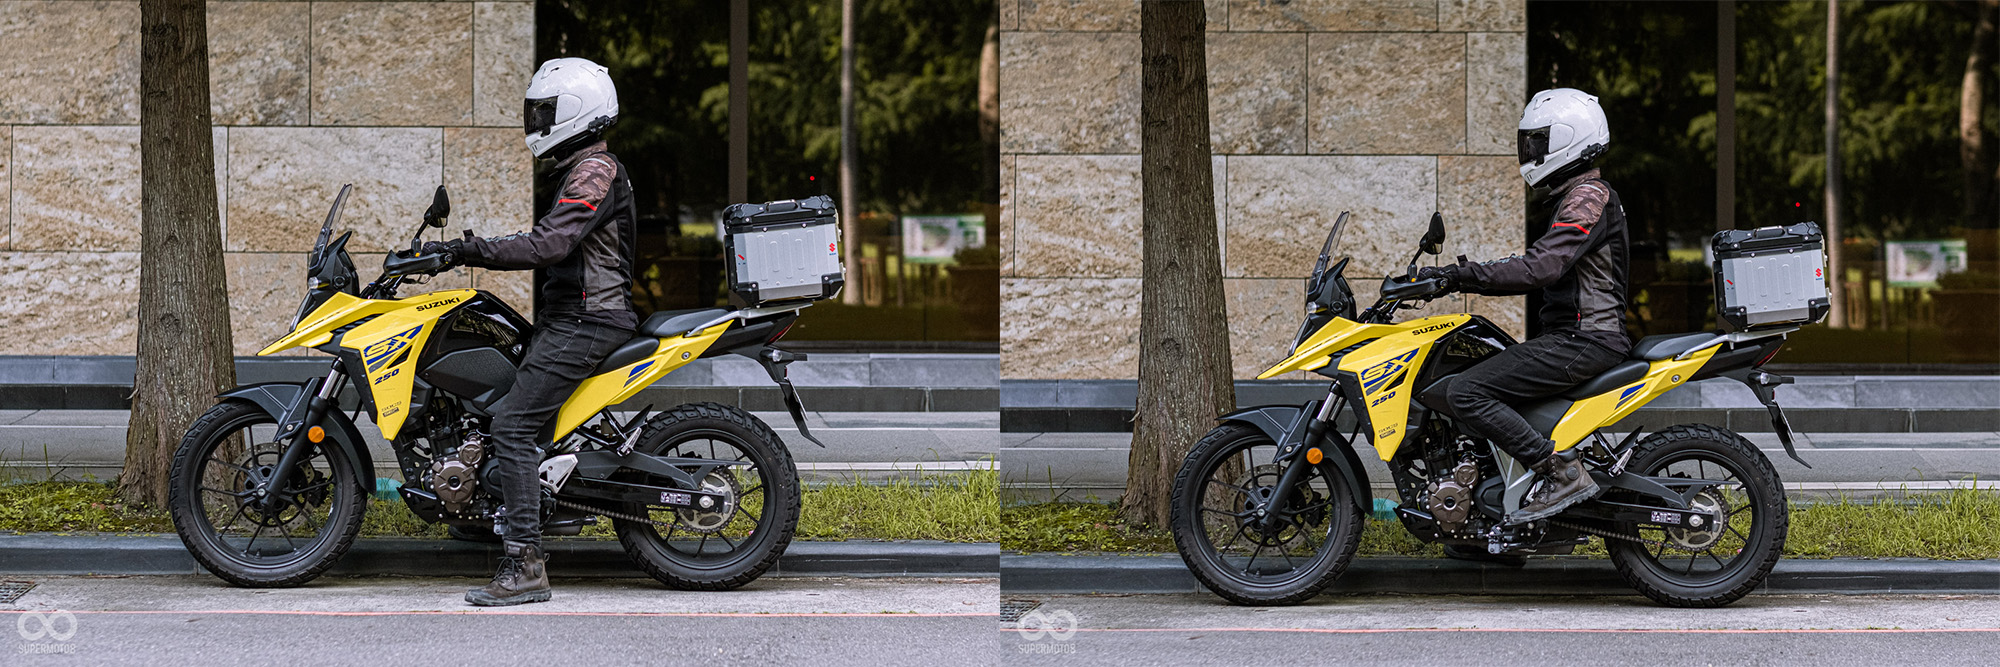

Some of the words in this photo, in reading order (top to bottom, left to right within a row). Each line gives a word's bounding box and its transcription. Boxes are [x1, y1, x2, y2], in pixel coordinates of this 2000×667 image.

[415, 297, 461, 312] SUZUKI
[1412, 321, 1456, 336] SUZUKI
[363, 324, 424, 363] SX
[1360, 348, 1420, 386] SX
[374, 368, 400, 386] 250
[1371, 391, 1397, 408] 250
